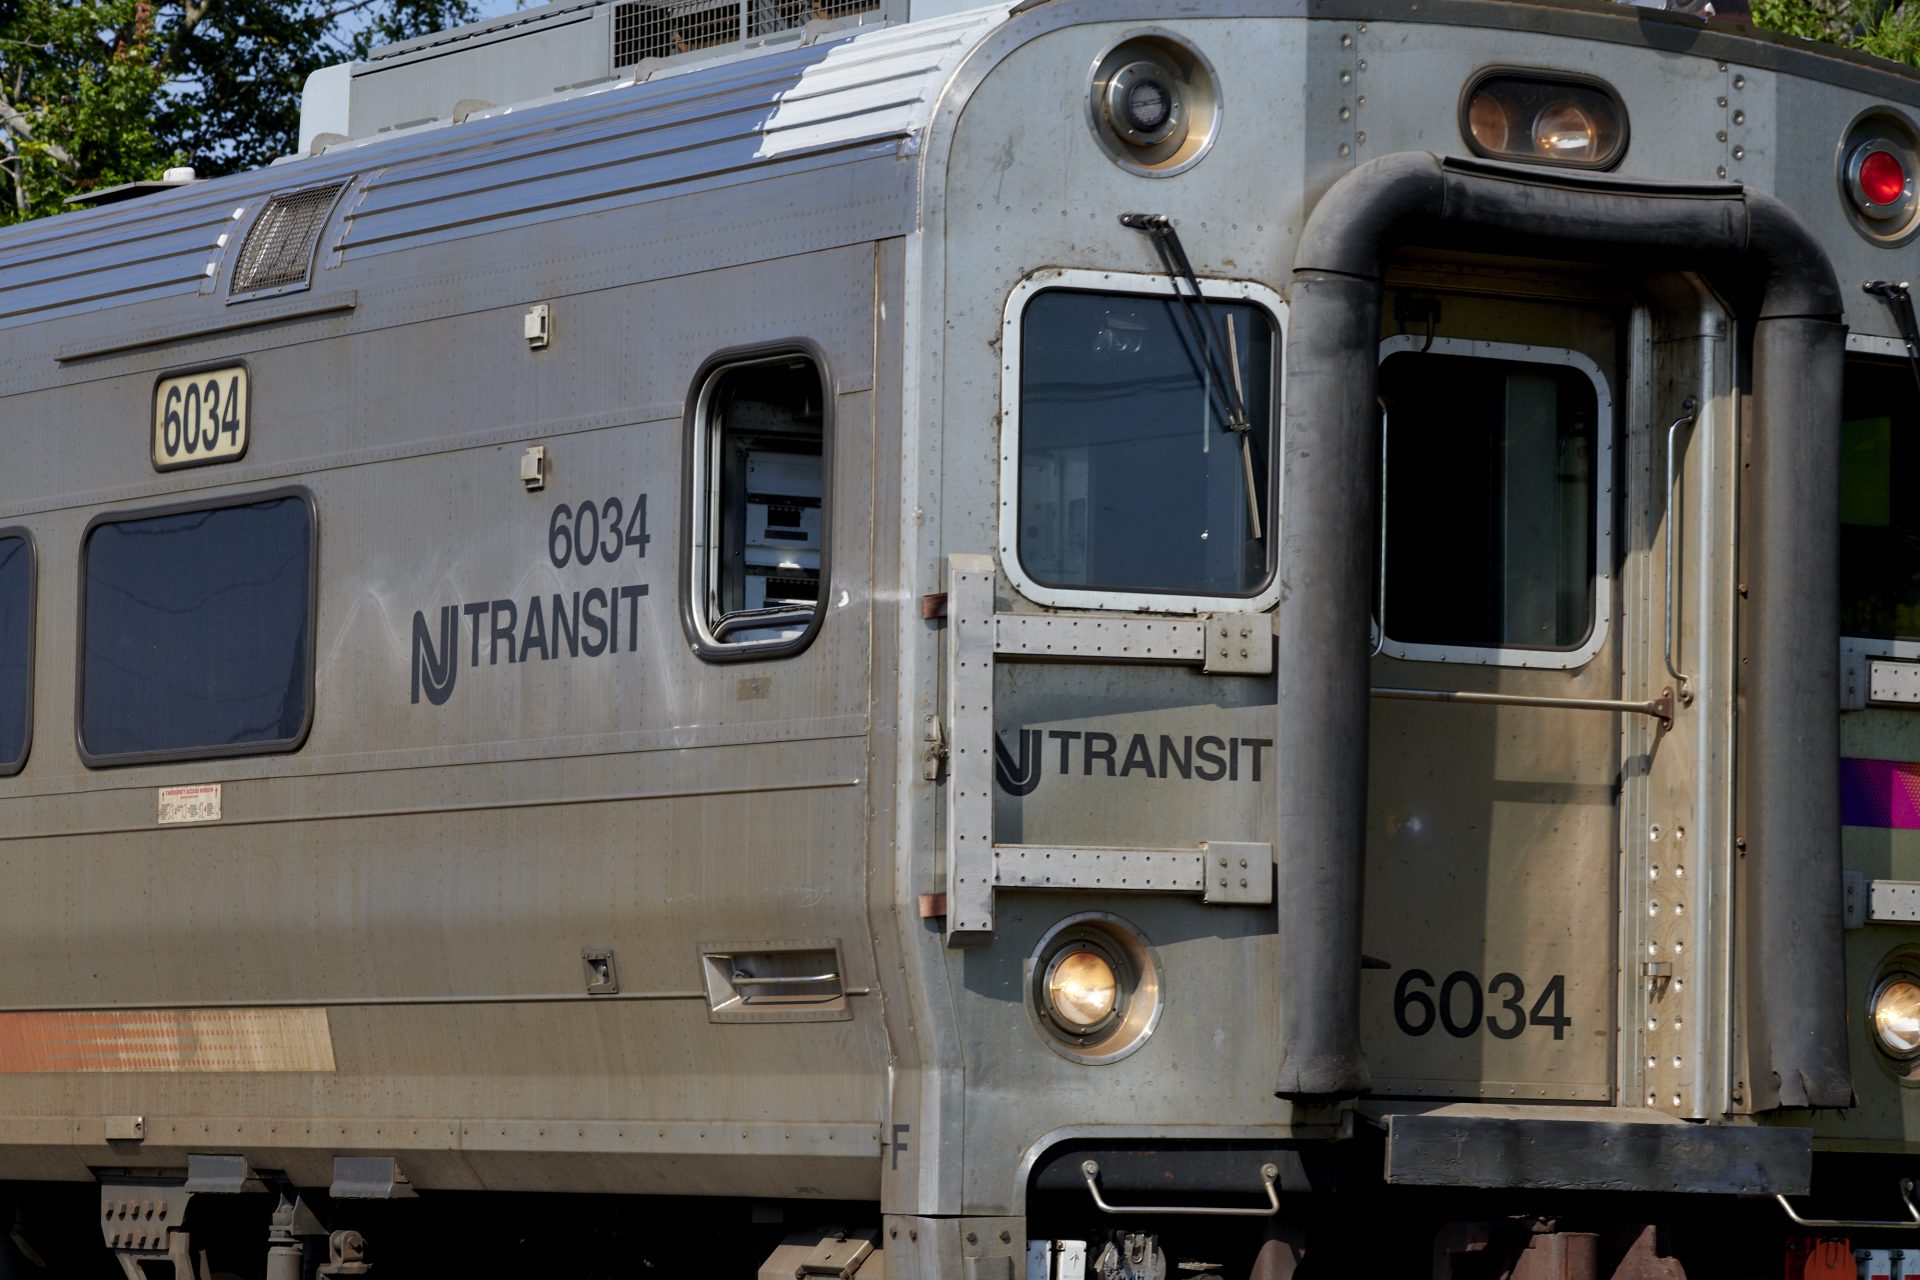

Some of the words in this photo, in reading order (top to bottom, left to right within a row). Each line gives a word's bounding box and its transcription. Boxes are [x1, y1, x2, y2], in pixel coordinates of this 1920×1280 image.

[164, 376, 239, 457] 6034
[549, 493, 650, 569] 6034
[411, 605, 459, 706] NJ
[463, 584, 649, 668] TRANSIT
[1048, 730, 1273, 782] TRANSIT
[1394, 968, 1572, 1040] 6034
[892, 1124, 910, 1170] F
